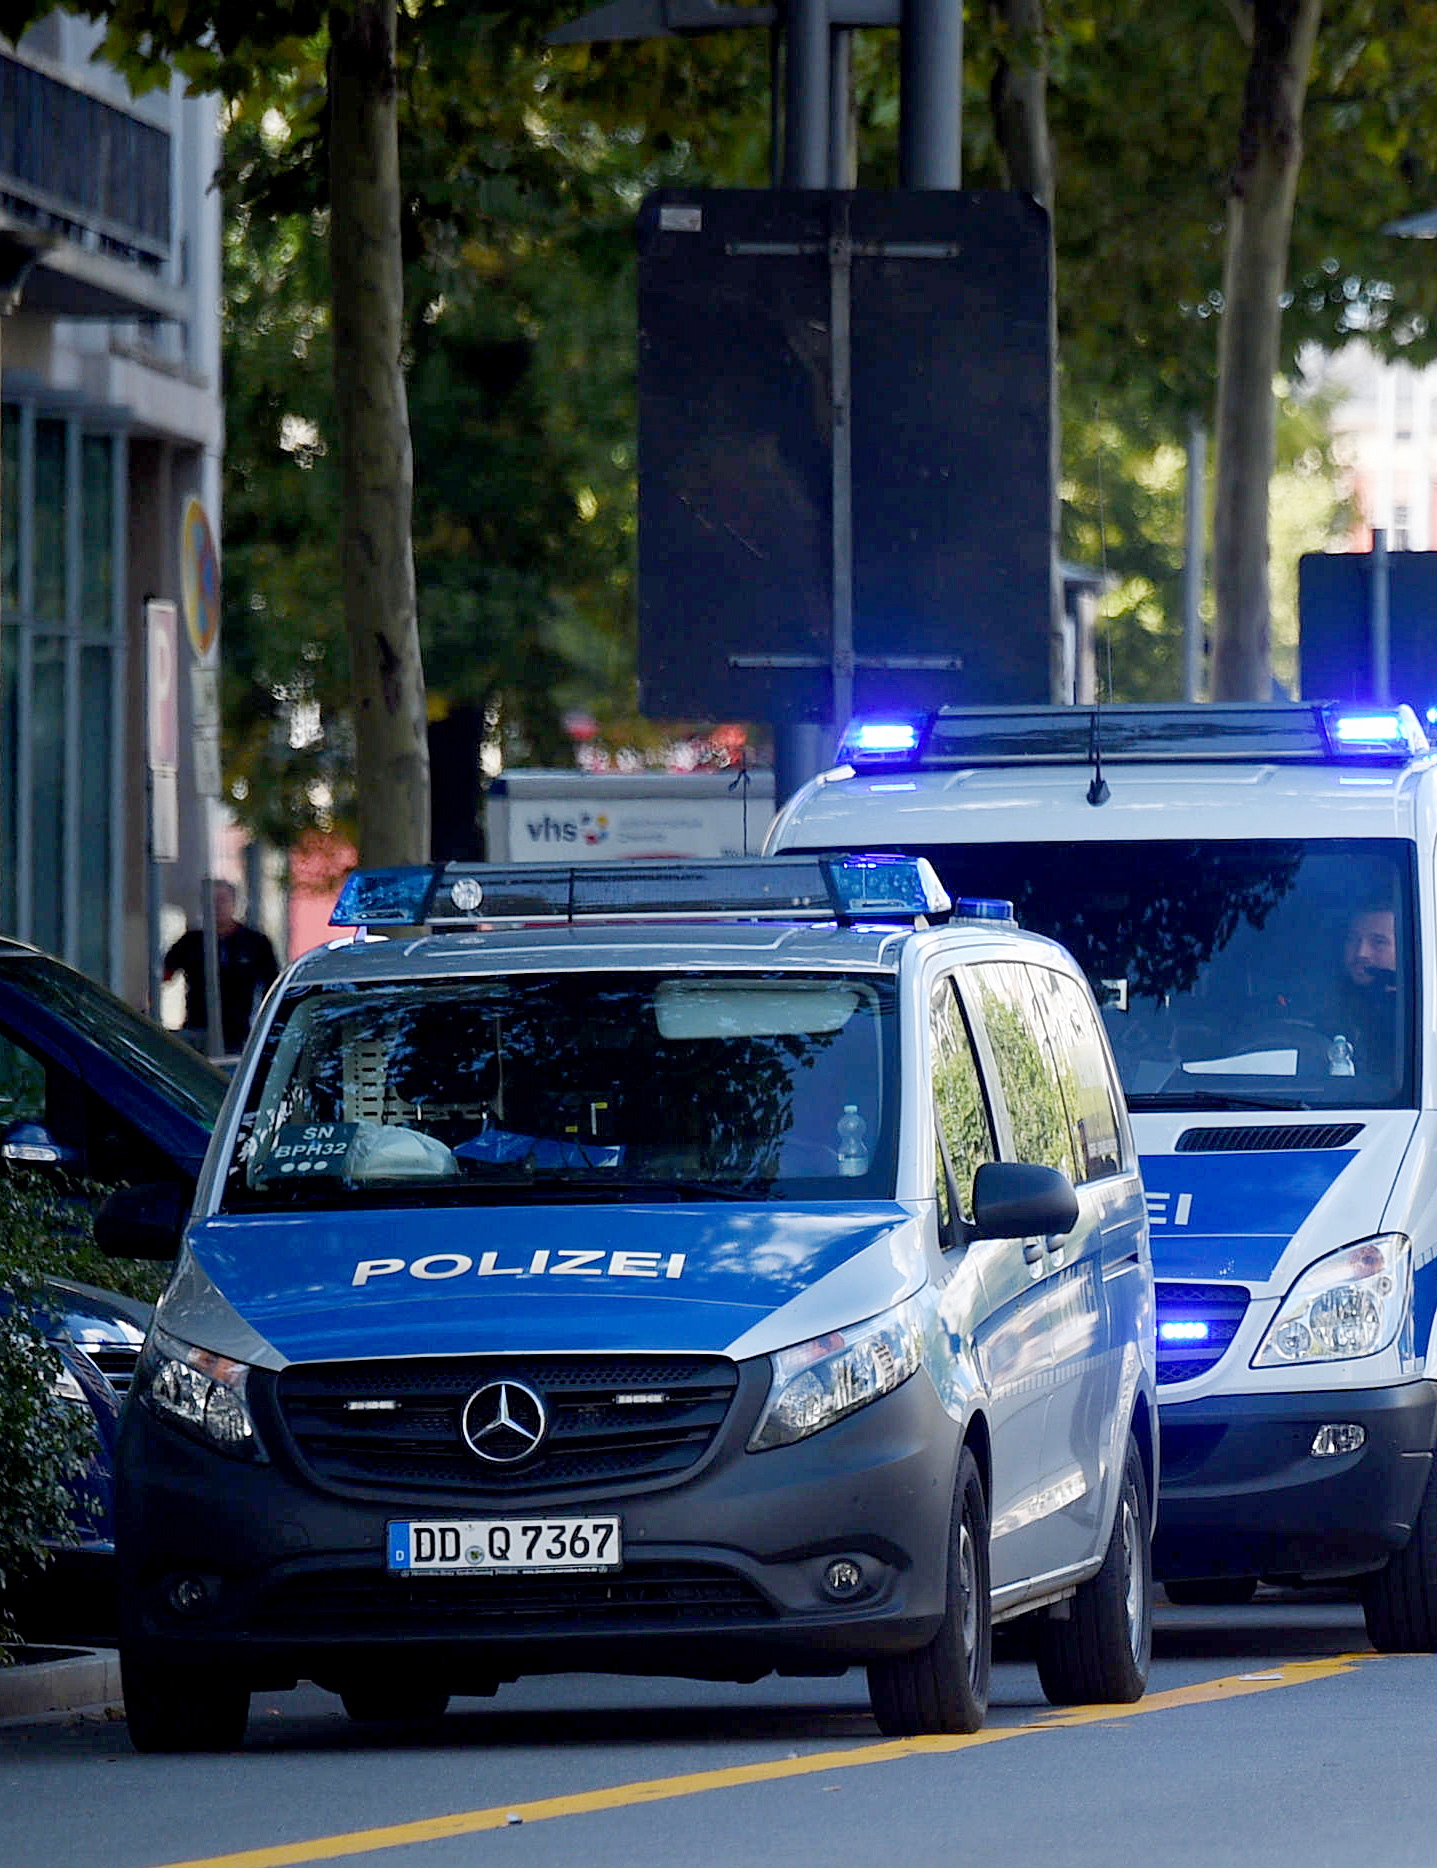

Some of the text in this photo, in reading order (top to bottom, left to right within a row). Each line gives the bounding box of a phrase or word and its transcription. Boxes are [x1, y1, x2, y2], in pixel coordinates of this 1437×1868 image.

[526, 814, 578, 842] vhs
[302, 1126, 335, 1140] SN
[274, 1142, 347, 1159] BPH32
[351, 1249, 687, 1287] POLIZEI
[413, 1523, 614, 1563] DD Q 7367
[395, 1550, 405, 1562] D
